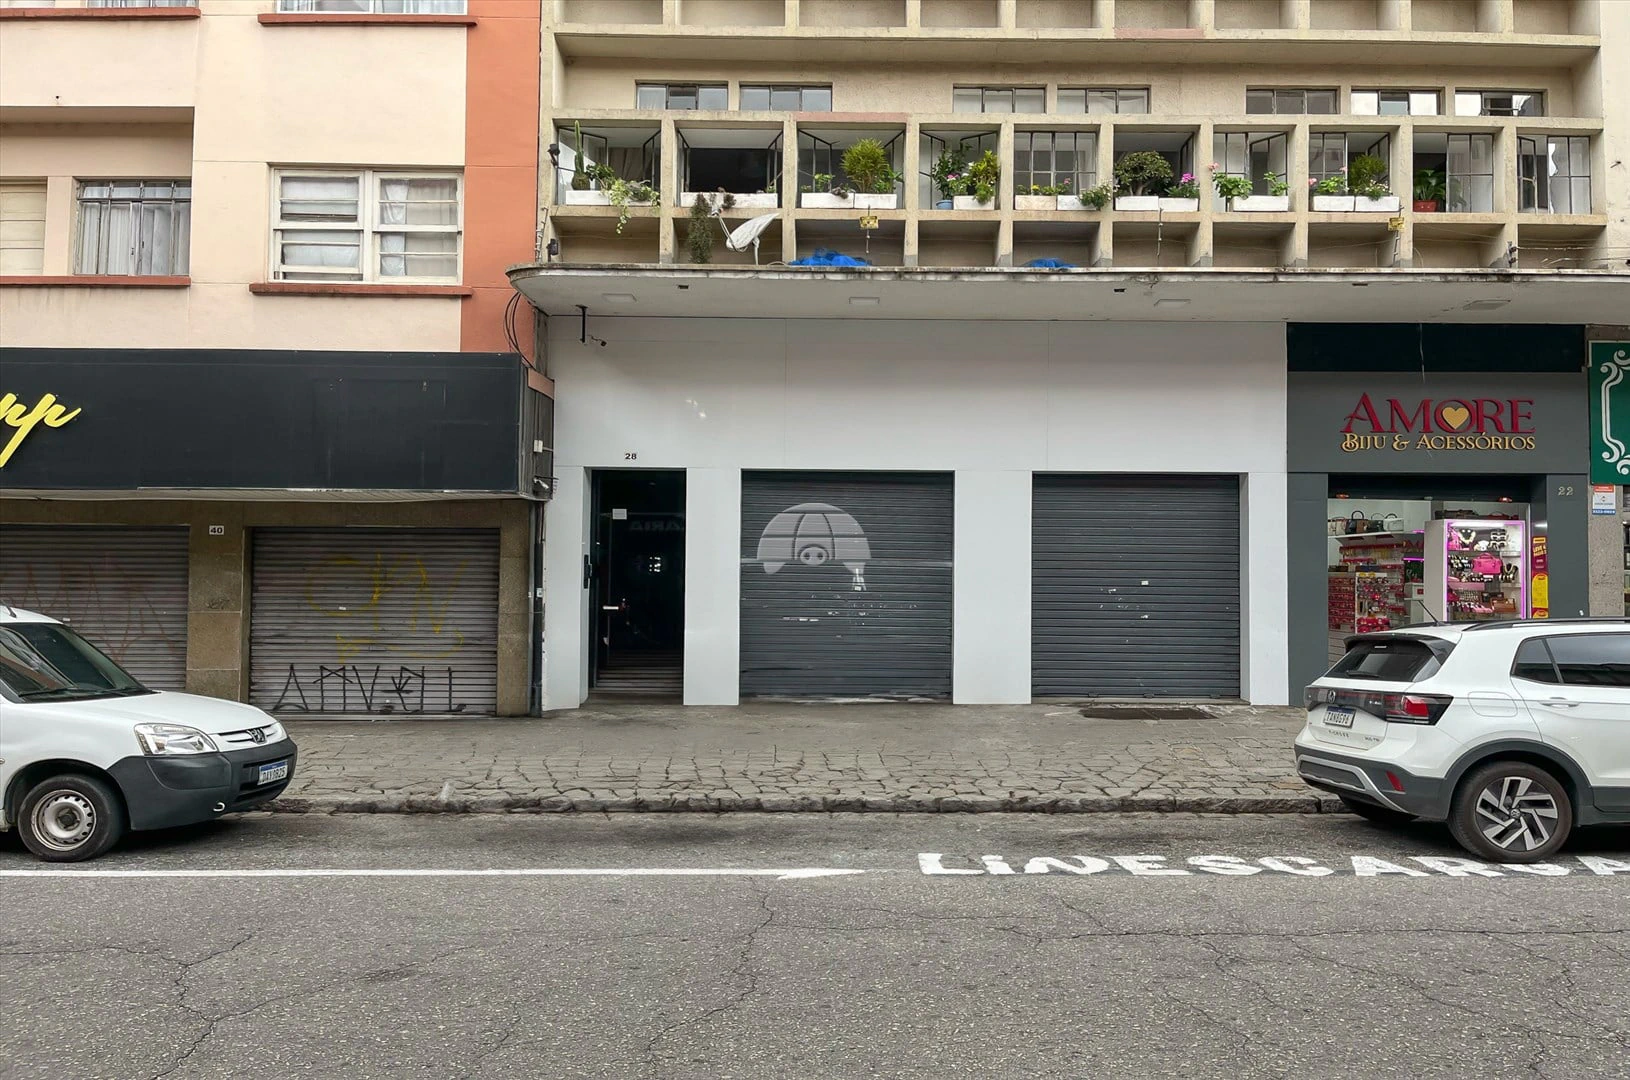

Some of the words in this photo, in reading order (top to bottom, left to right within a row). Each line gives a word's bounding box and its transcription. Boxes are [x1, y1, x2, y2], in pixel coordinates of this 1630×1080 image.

[1340, 392, 1536, 433] AMORE
[1341, 433, 1387, 452] BIJU
[1392, 433, 1410, 451] &
[1416, 432, 1536, 450] ACESSÓRIOS
[1557, 486, 1574, 496] 22
